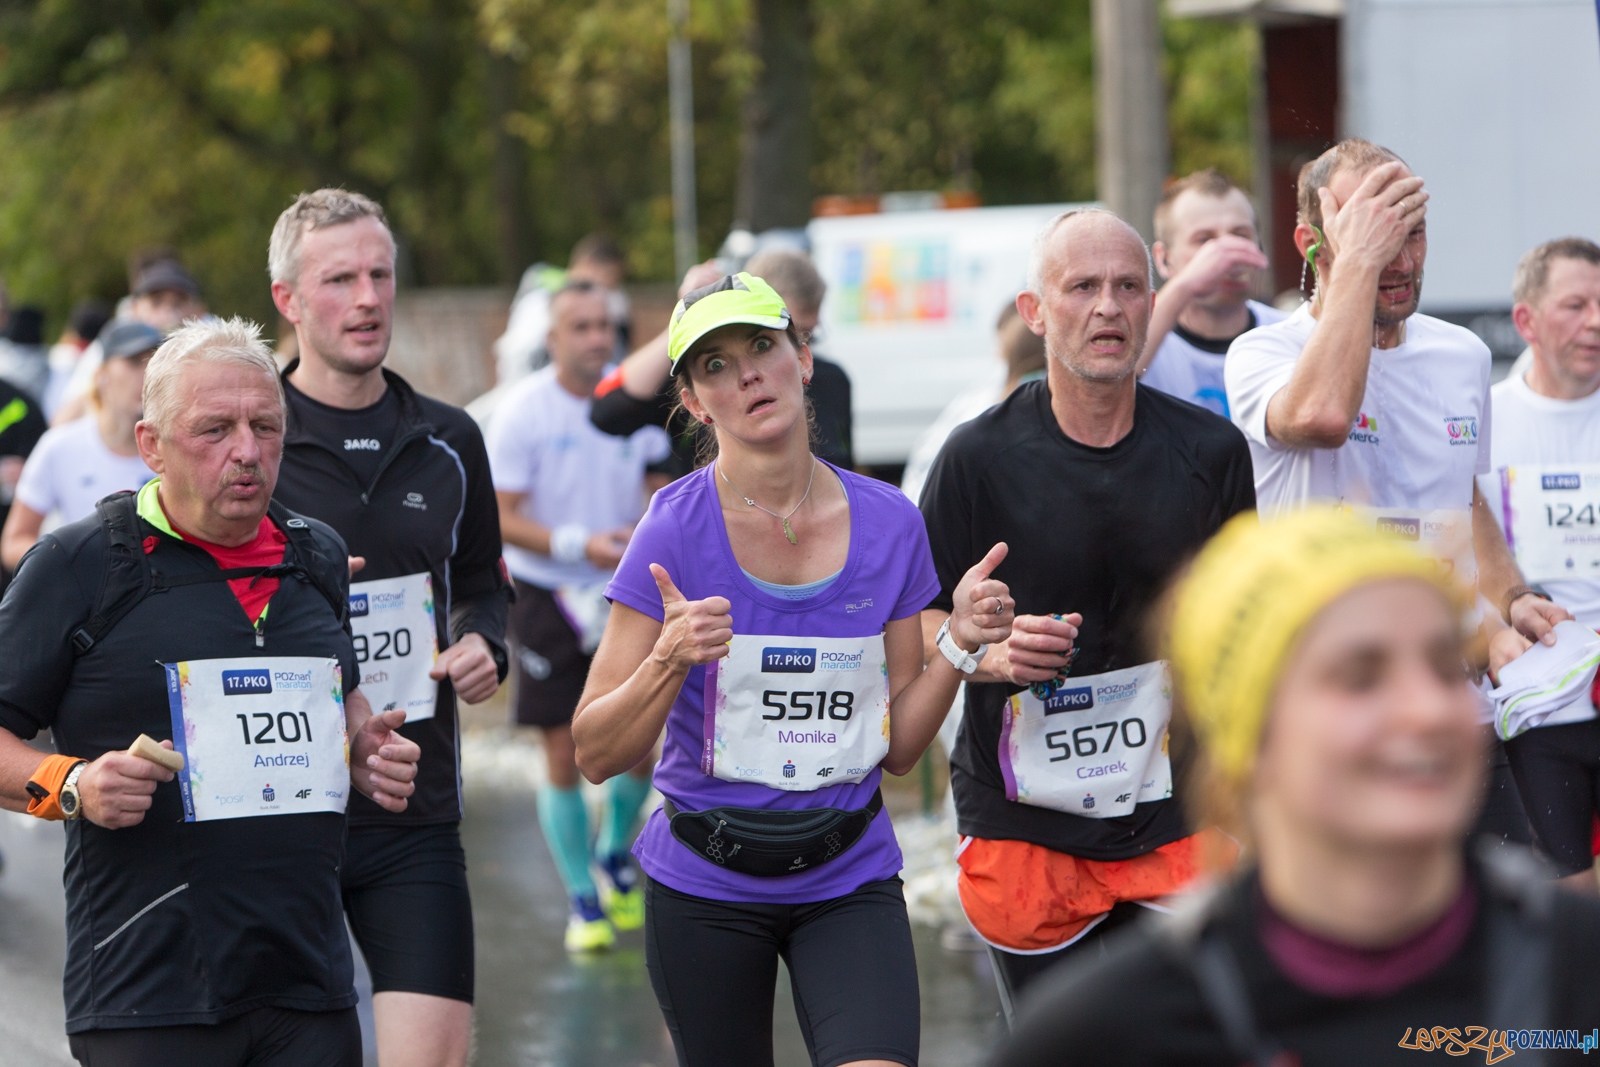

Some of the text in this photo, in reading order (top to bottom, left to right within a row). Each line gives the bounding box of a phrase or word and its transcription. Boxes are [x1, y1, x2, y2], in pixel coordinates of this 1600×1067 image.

[344, 438, 380, 451] JAKO
[1544, 503, 1600, 527] 124
[820, 660, 861, 669] maraton
[276, 680, 312, 689] maraton
[1097, 689, 1138, 703] maraton
[762, 690, 854, 721] 5518
[236, 711, 313, 744] 1201
[778, 730, 836, 743] Monika
[1045, 717, 1147, 762] 5670
[254, 752, 310, 768] Andrzej
[817, 767, 834, 777] 4F
[1076, 760, 1128, 779] Czarek
[295, 788, 312, 799] 4F
[1115, 793, 1132, 803] 4F
